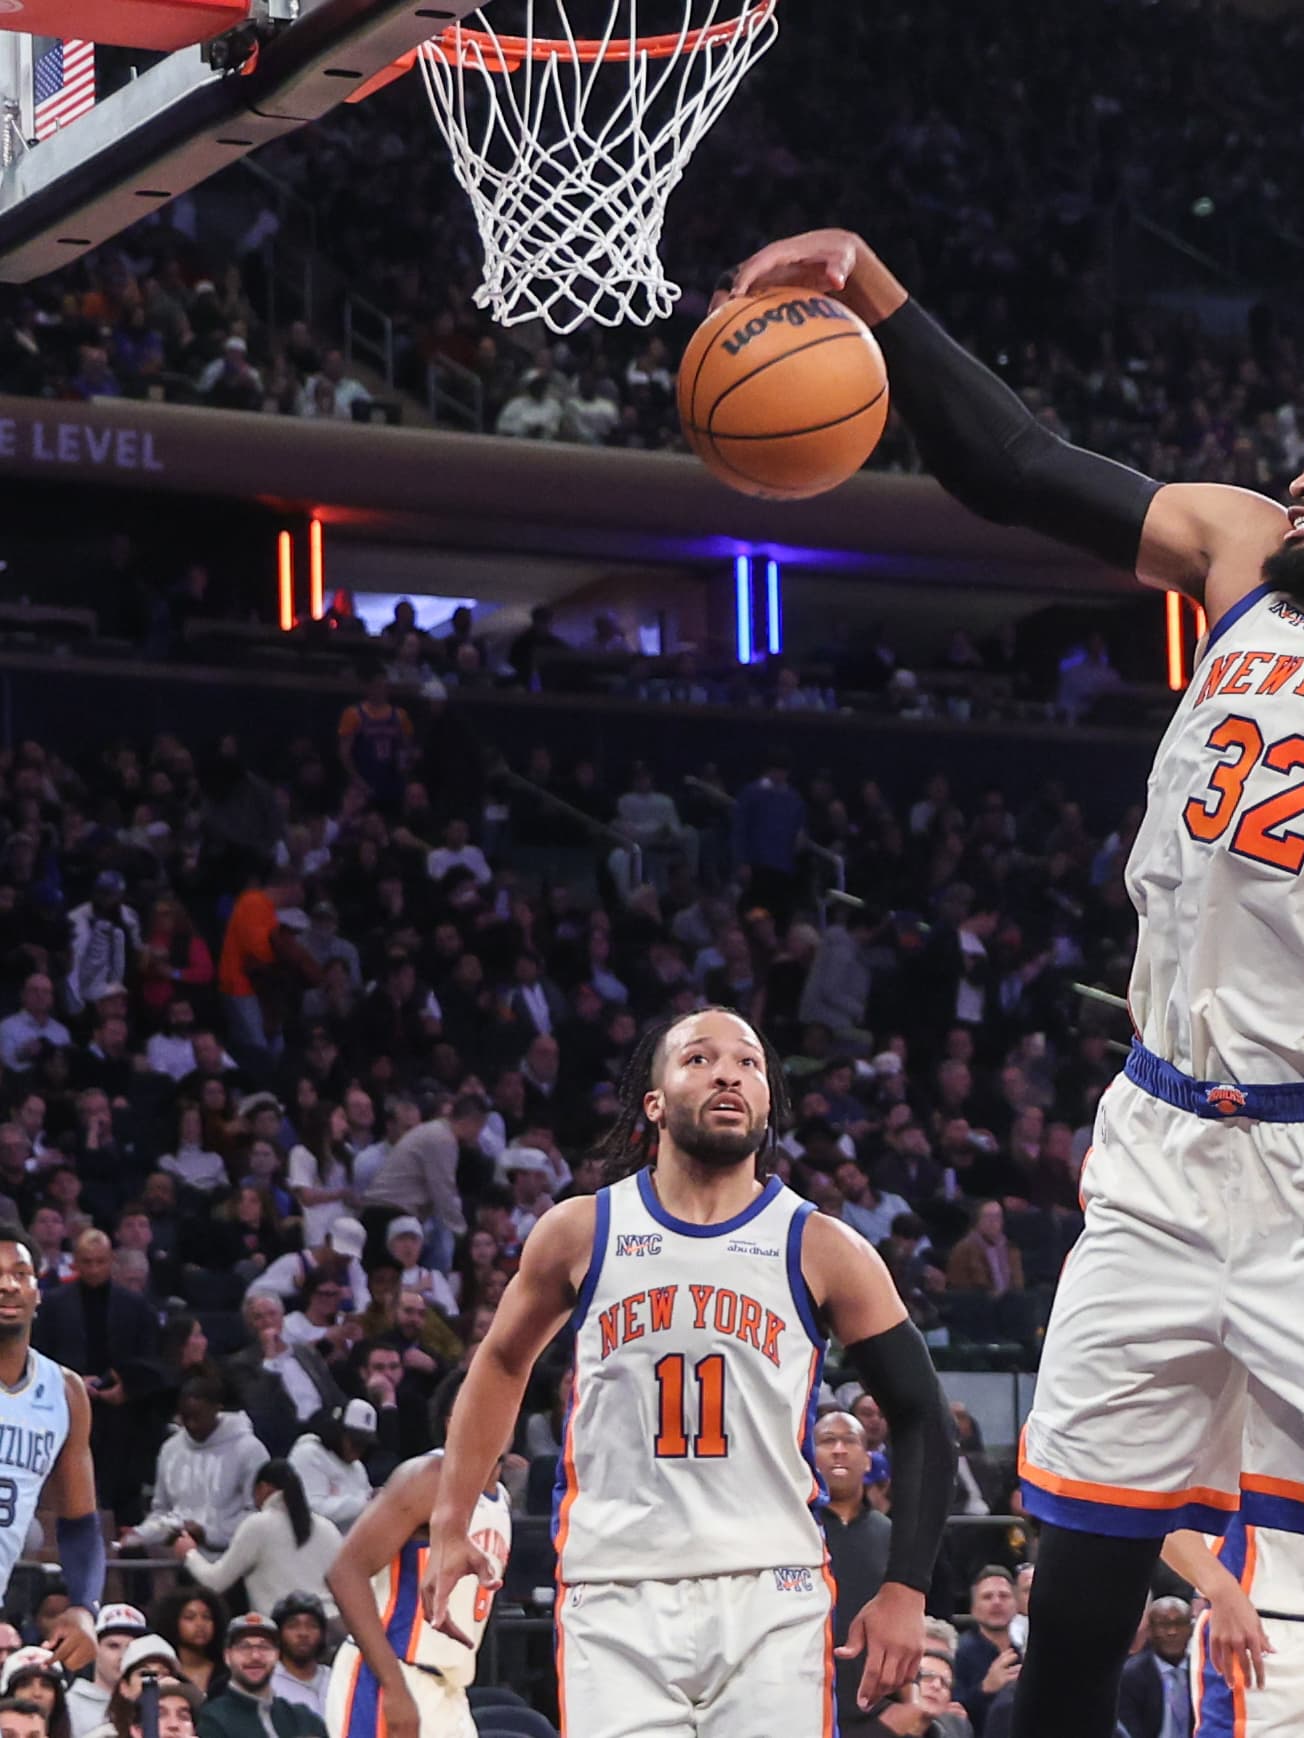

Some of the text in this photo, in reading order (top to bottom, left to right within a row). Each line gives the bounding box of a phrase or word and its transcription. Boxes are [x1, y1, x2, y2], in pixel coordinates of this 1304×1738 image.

[721, 297, 852, 356] Wilson
[32, 420, 165, 471] LEVEL
[616, 1233, 663, 1257] NYC
[727, 1244, 748, 1254] abu
[598, 1284, 787, 1369] NEW YORK
[654, 1352, 729, 1459] 11
[773, 1567, 814, 1593] NYC
